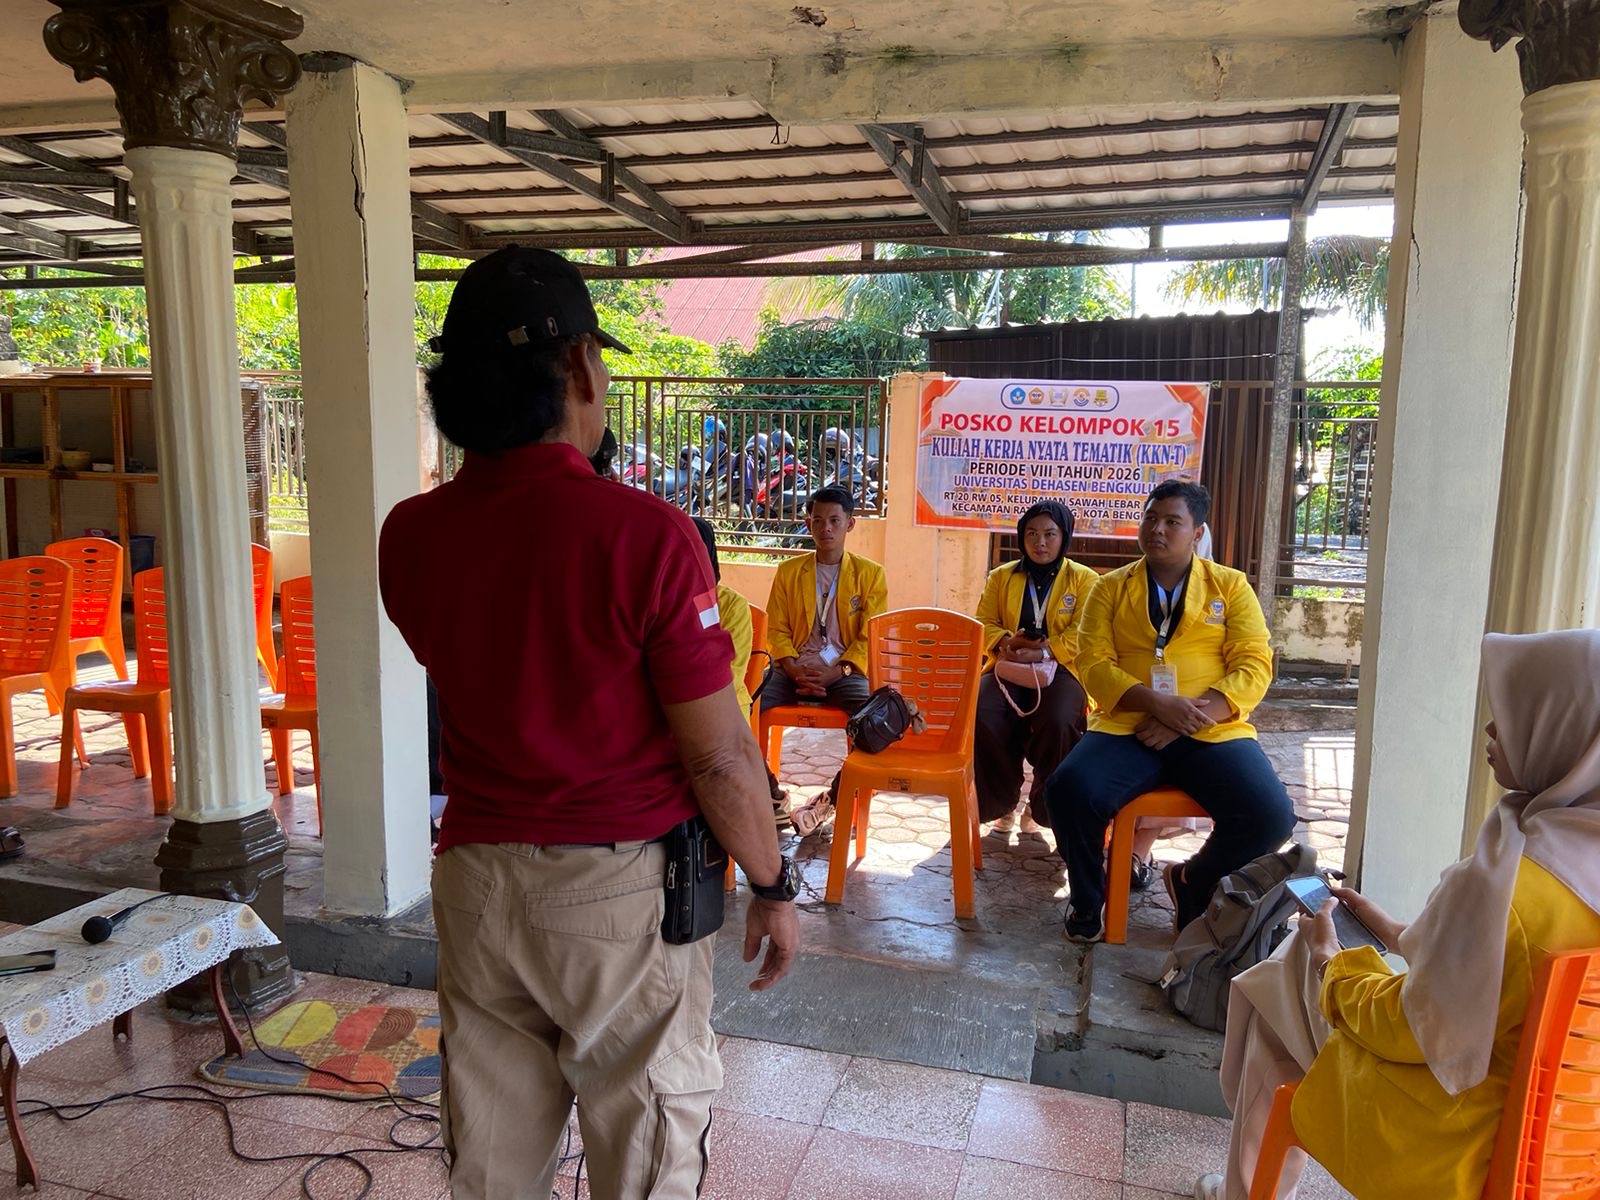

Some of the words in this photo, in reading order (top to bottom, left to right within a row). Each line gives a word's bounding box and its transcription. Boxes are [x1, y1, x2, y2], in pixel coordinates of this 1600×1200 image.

[941, 413, 1012, 432] POSKO
[1020, 415, 1145, 436] KELOMPOK
[1154, 419, 1180, 437] 15
[931, 437, 980, 457] KULIAH
[984, 439, 1024, 459] KERJA
[1027, 440, 1068, 461] NYATA
[1073, 442, 1133, 464] TEMATIK
[1136, 443, 1186, 468] (KKN-T)
[970, 462, 1026, 475] PERIODE
[1031, 464, 1053, 477] VIII
[1057, 466, 1103, 479] TAHUN
[1108, 468, 1141, 481] 2026
[954, 475, 1028, 489] UNIVERSITAS
[1032, 479, 1087, 492] DEHASEN
[1091, 481, 1156, 494] BENGKULU
[944, 492, 955, 500] RT
[958, 493, 969, 501] 20
[990, 494, 1004, 504] 05,
[1069, 497, 1105, 507] SAWAH
[1108, 499, 1140, 509] LEBAR
[952, 503, 1011, 514] KECAMATAN
[1083, 509, 1110, 519] KOTA
